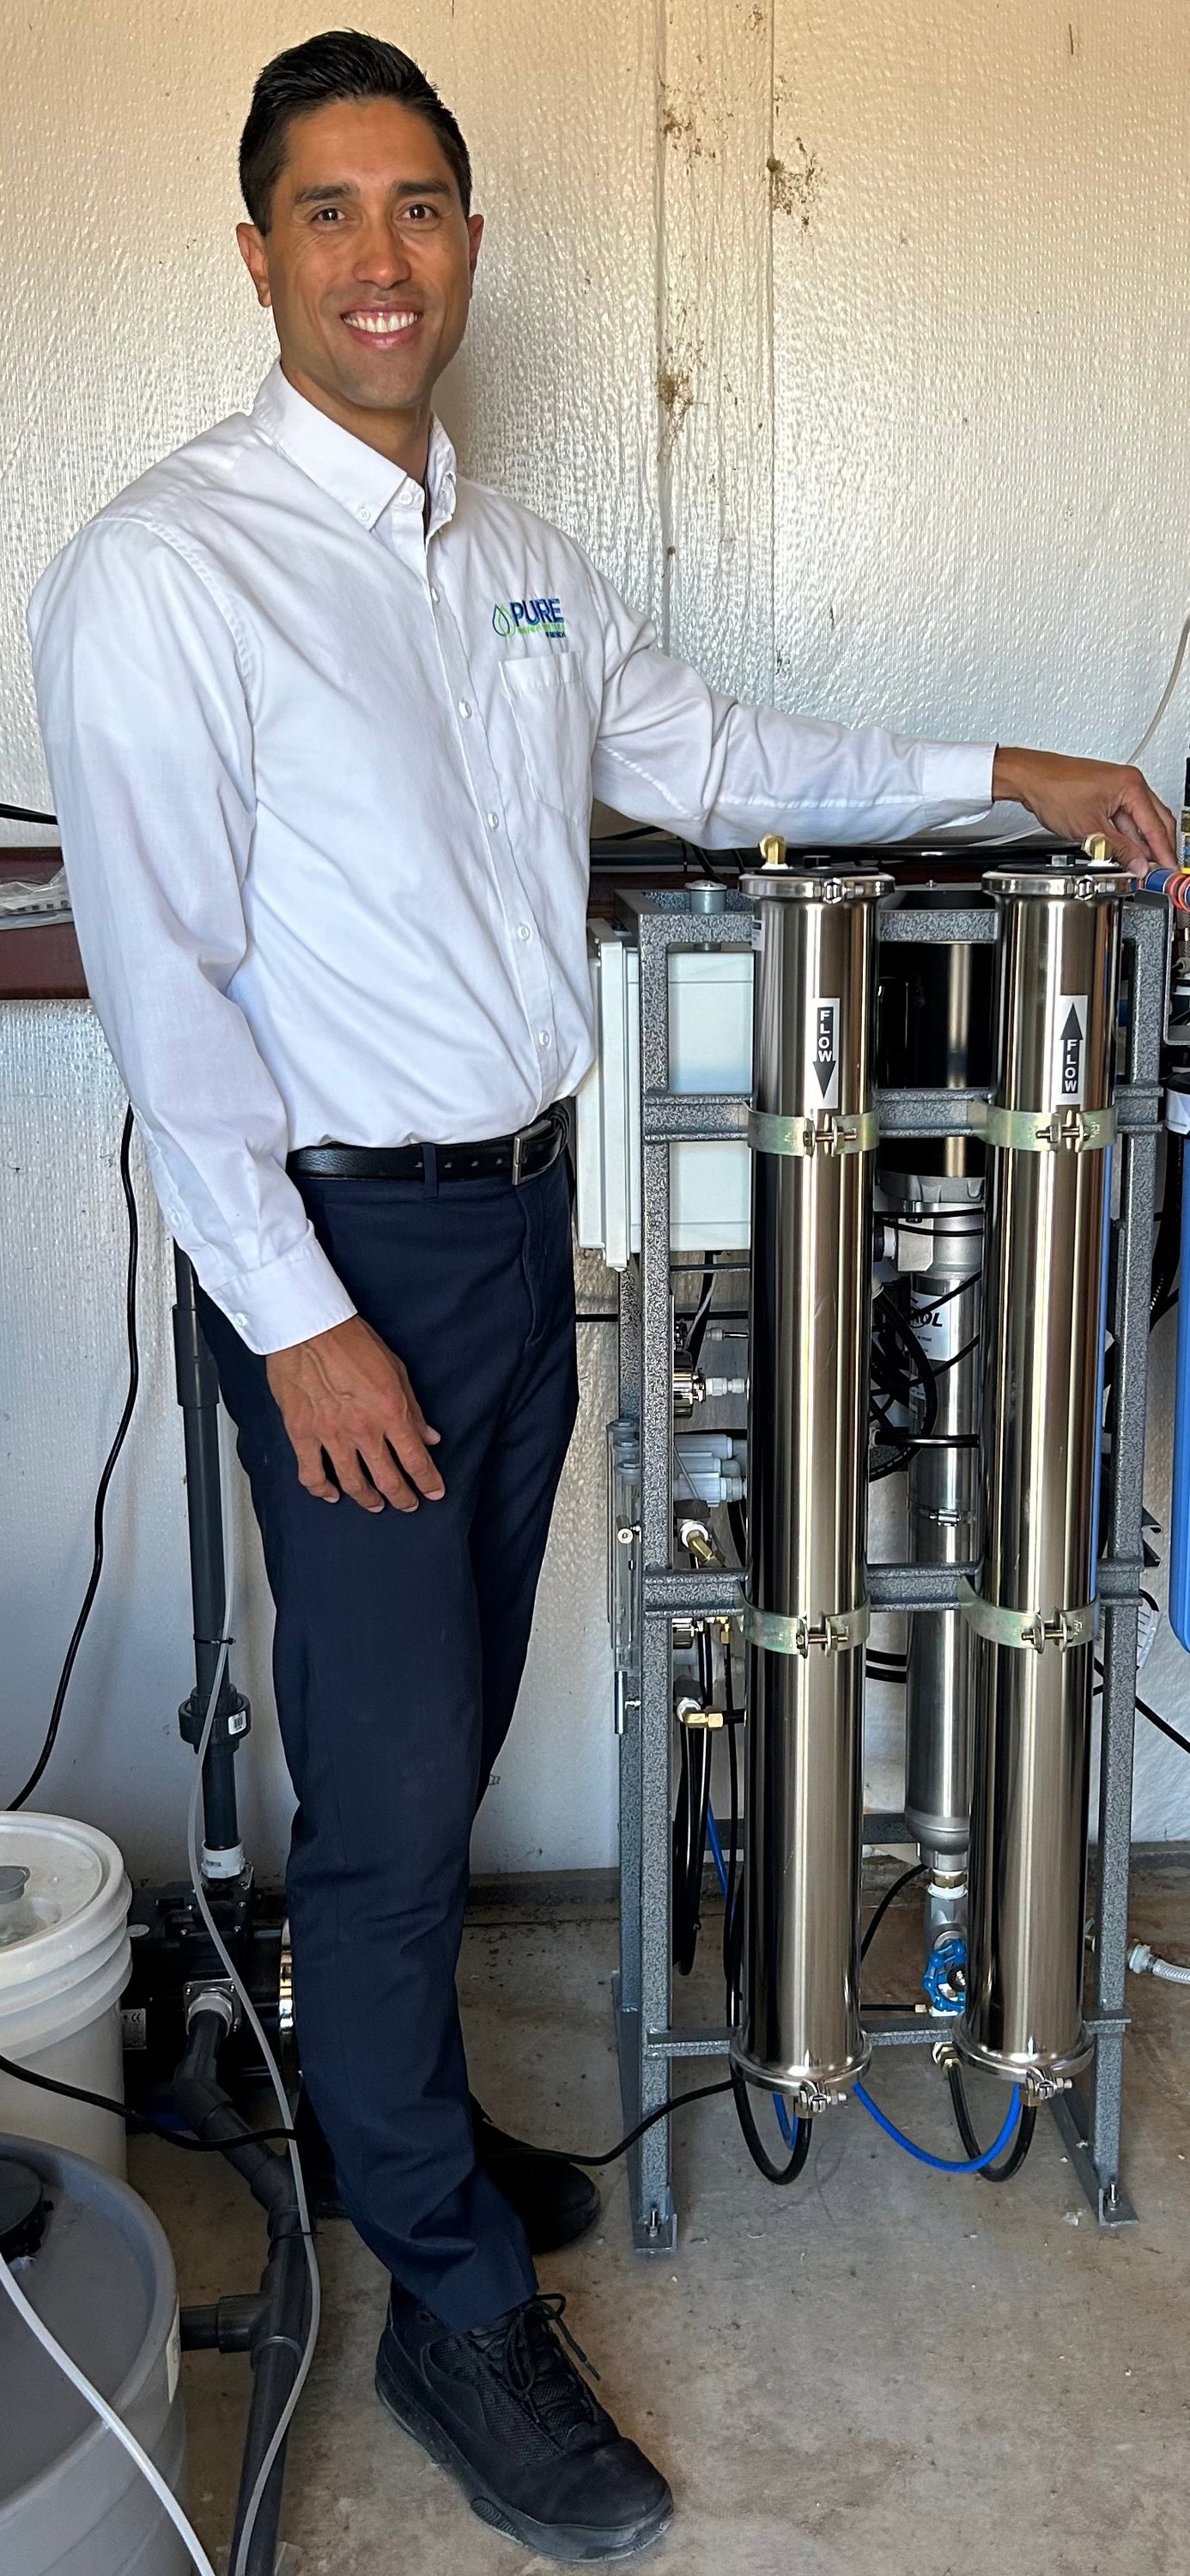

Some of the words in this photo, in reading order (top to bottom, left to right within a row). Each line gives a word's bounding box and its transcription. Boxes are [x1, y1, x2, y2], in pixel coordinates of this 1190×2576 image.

[510, 598, 564, 627] PURE
[817, 1010, 832, 1062] FLOW
[1064, 1039, 1078, 1092] FLOW
